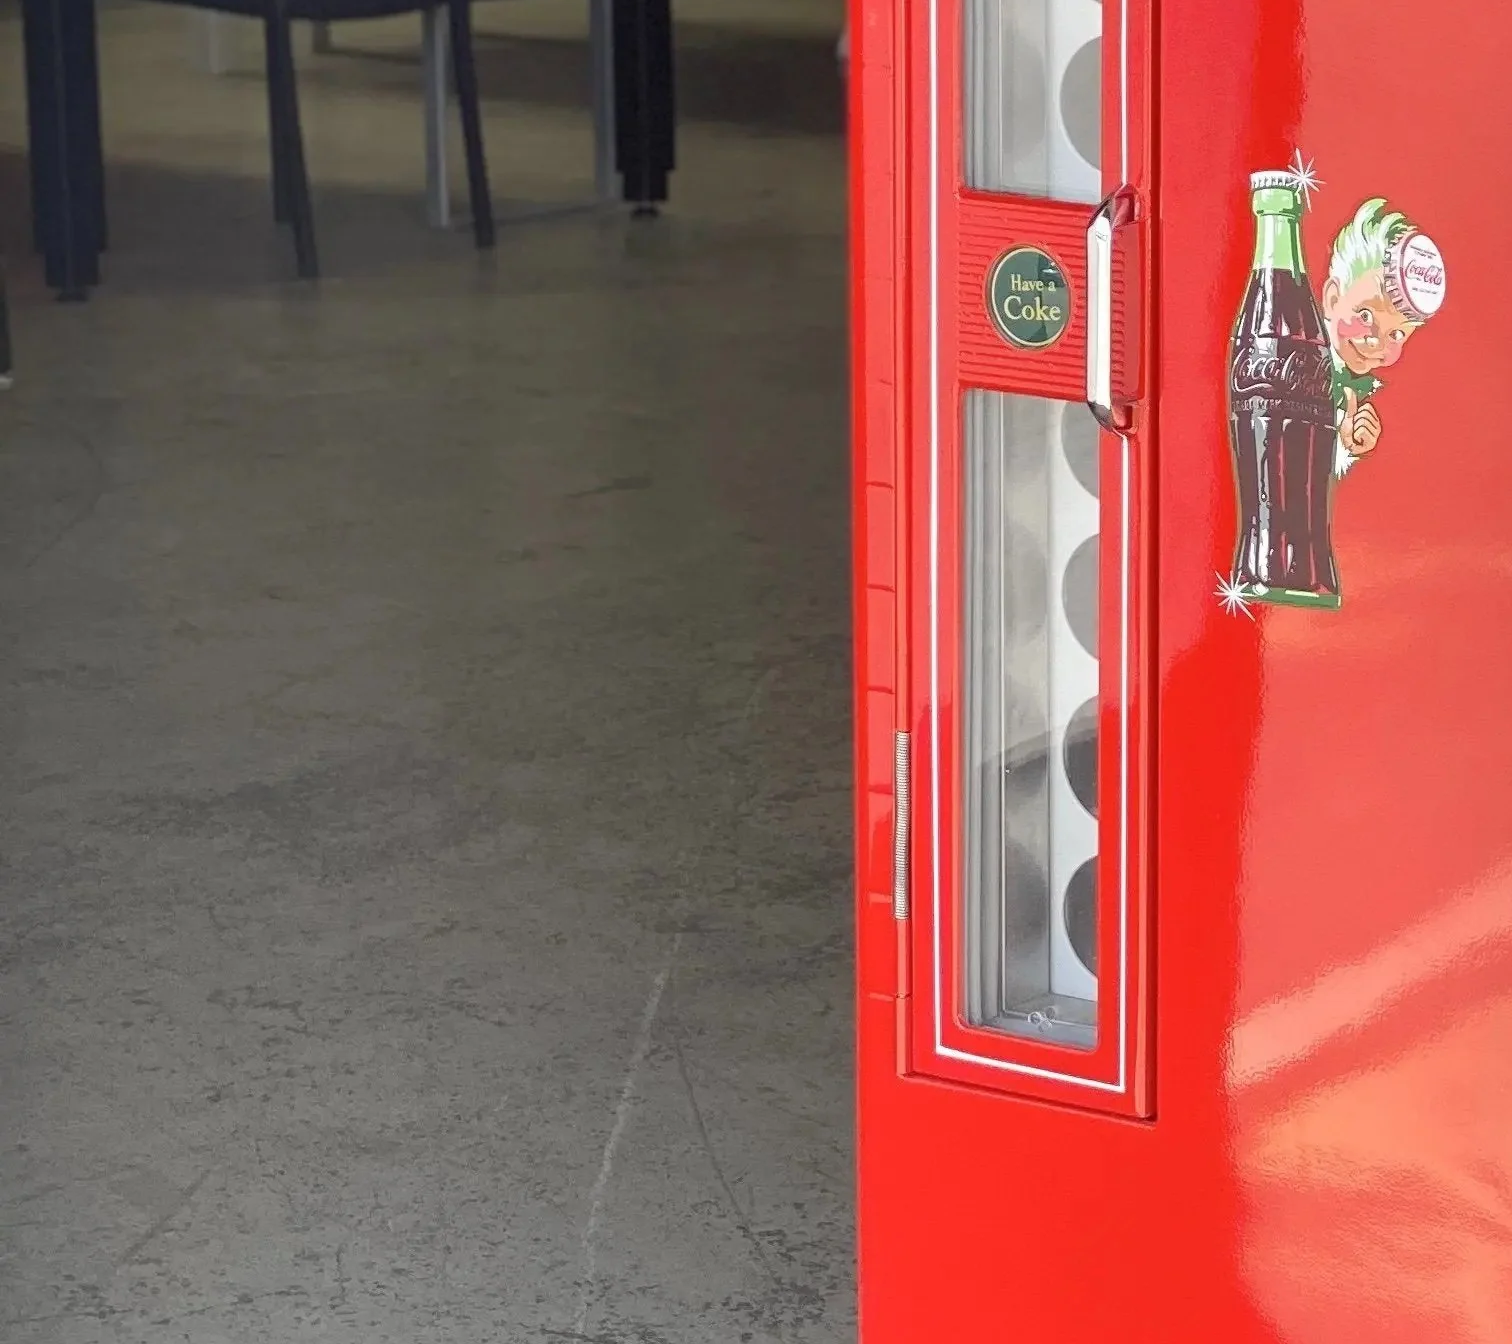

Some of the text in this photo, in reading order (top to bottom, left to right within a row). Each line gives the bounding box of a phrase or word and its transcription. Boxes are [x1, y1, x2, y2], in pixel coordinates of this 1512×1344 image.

[1011, 273, 1056, 292] Have a
[1003, 295, 1061, 321] Coke
